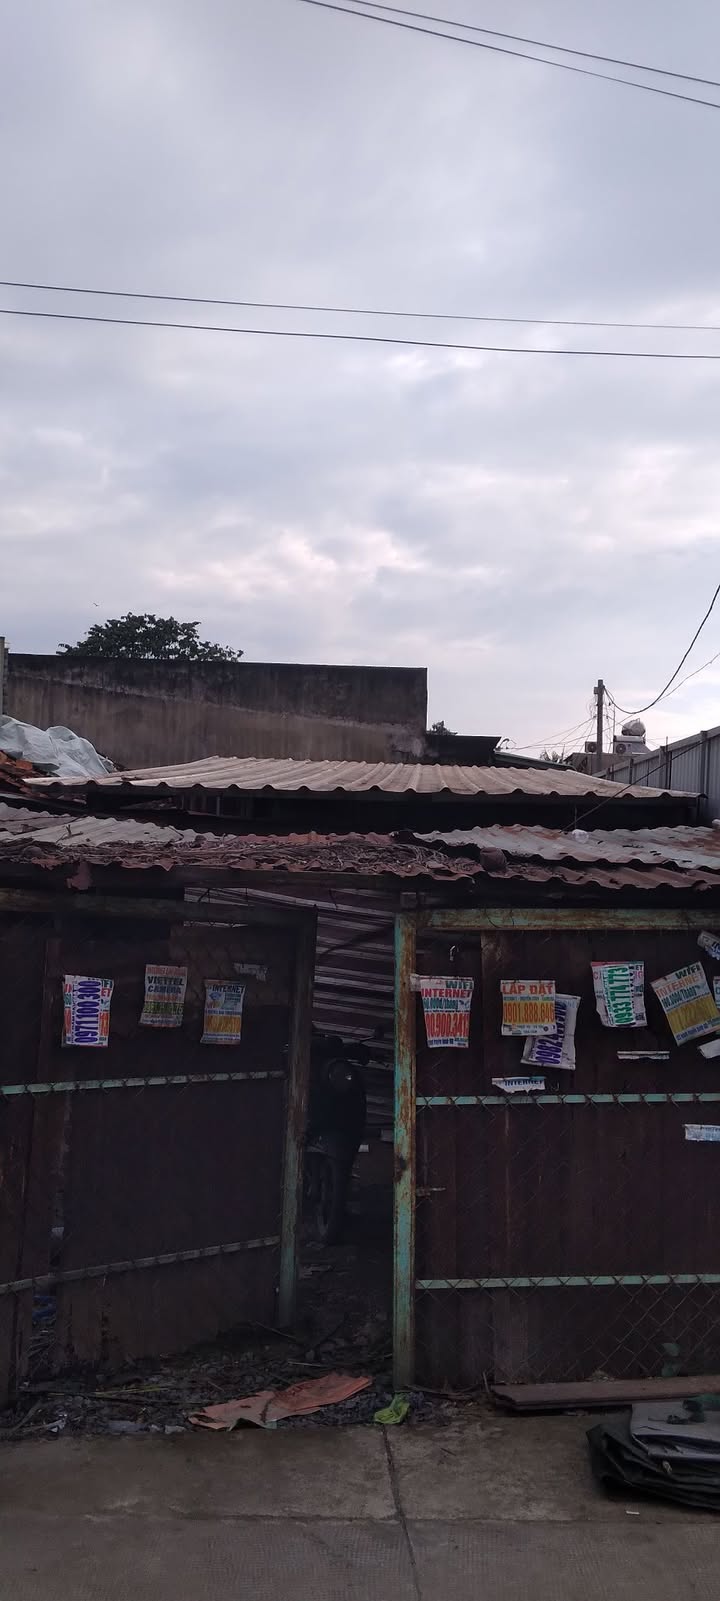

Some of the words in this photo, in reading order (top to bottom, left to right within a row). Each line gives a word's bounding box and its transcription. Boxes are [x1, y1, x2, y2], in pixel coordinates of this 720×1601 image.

[147, 976, 184, 985] VIETTEL
[421, 988, 472, 998] INTERNET
[74, 981, 101, 1043] 0971.100.300
